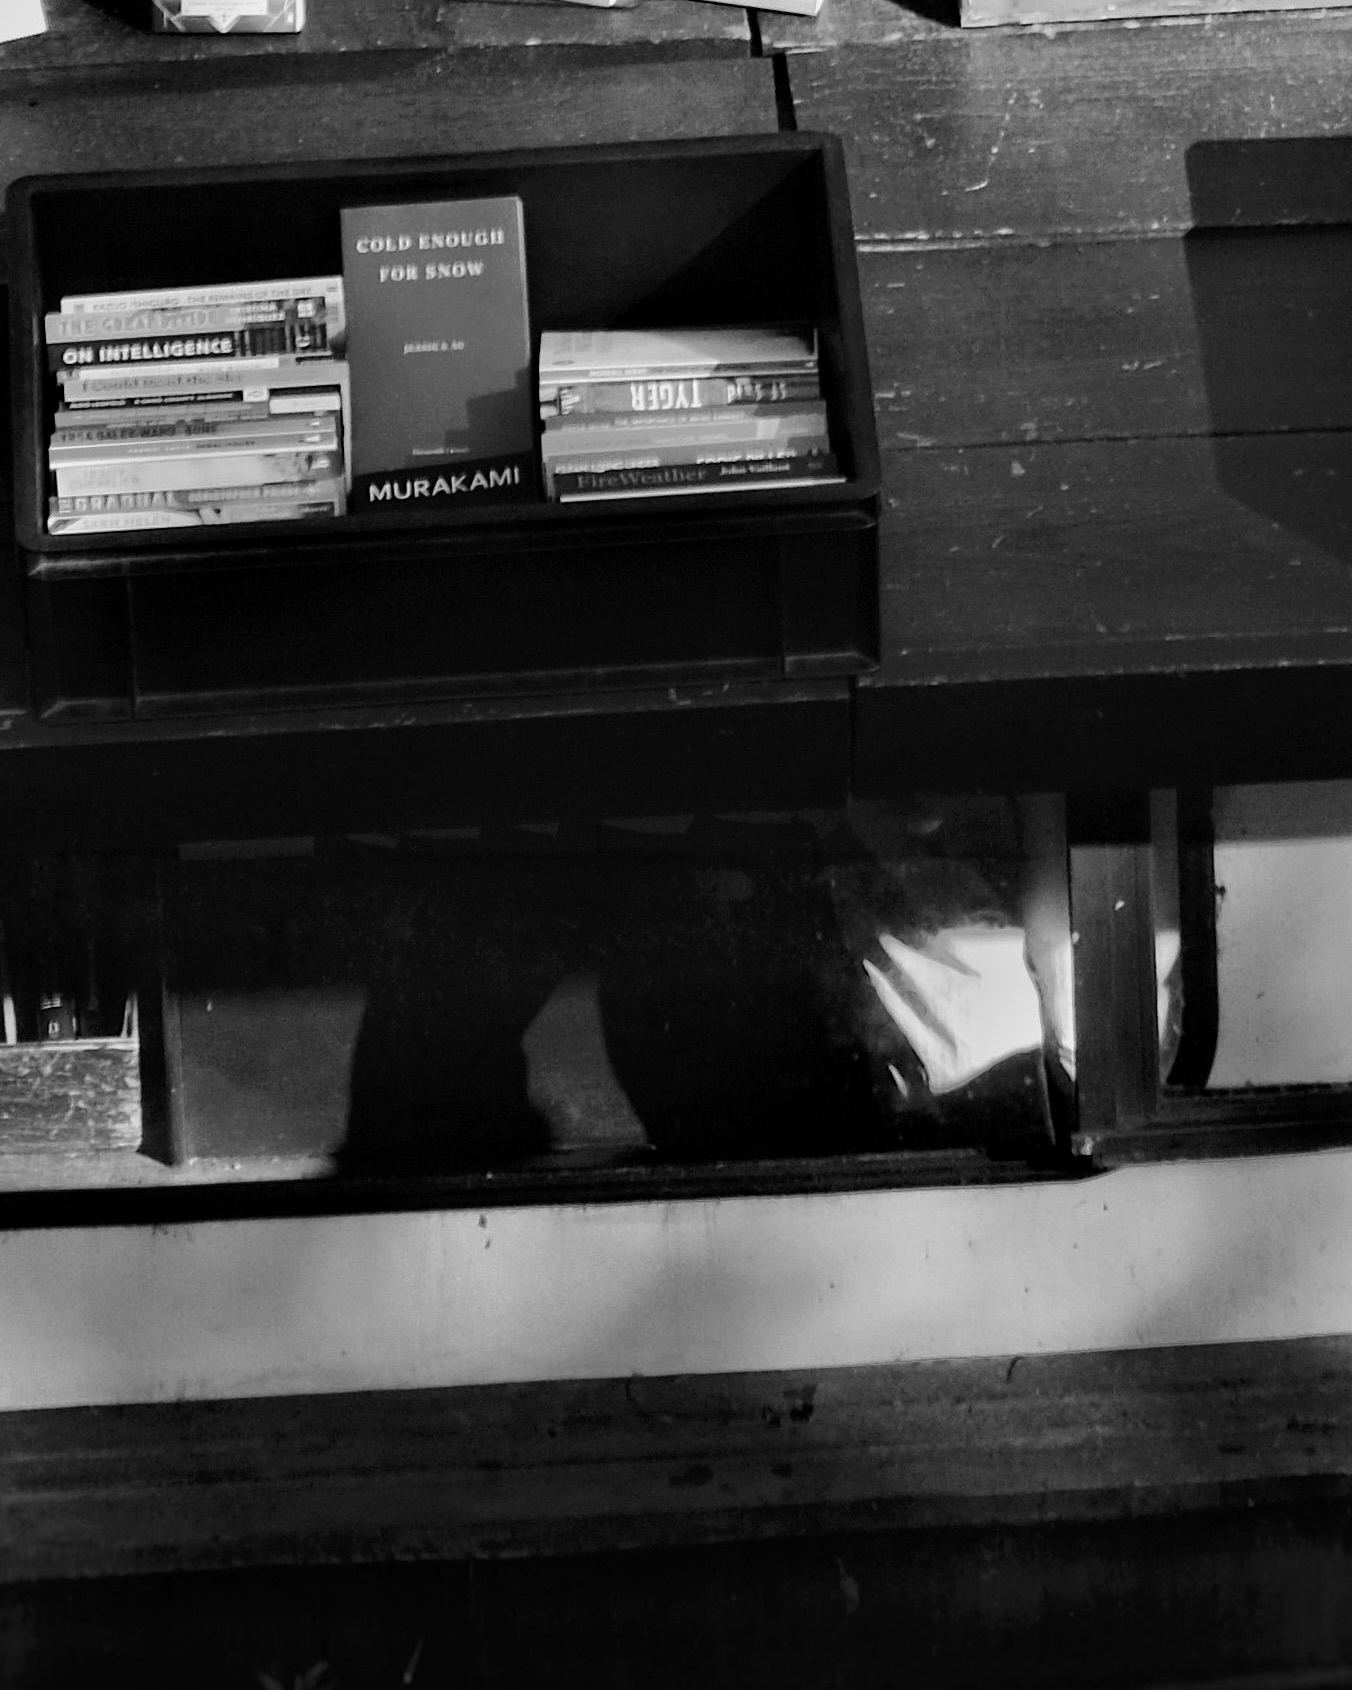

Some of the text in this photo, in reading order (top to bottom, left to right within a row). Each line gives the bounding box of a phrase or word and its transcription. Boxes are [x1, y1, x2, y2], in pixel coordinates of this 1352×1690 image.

[356, 228, 505, 254] COLD ENOUGH
[379, 260, 485, 283] FOR SNOW
[62, 337, 234, 366] ON INTELLIGENCE
[630, 378, 702, 411] TYGER
[368, 466, 520, 503] MURAKAMI
[73, 490, 178, 513] GRADUAL
